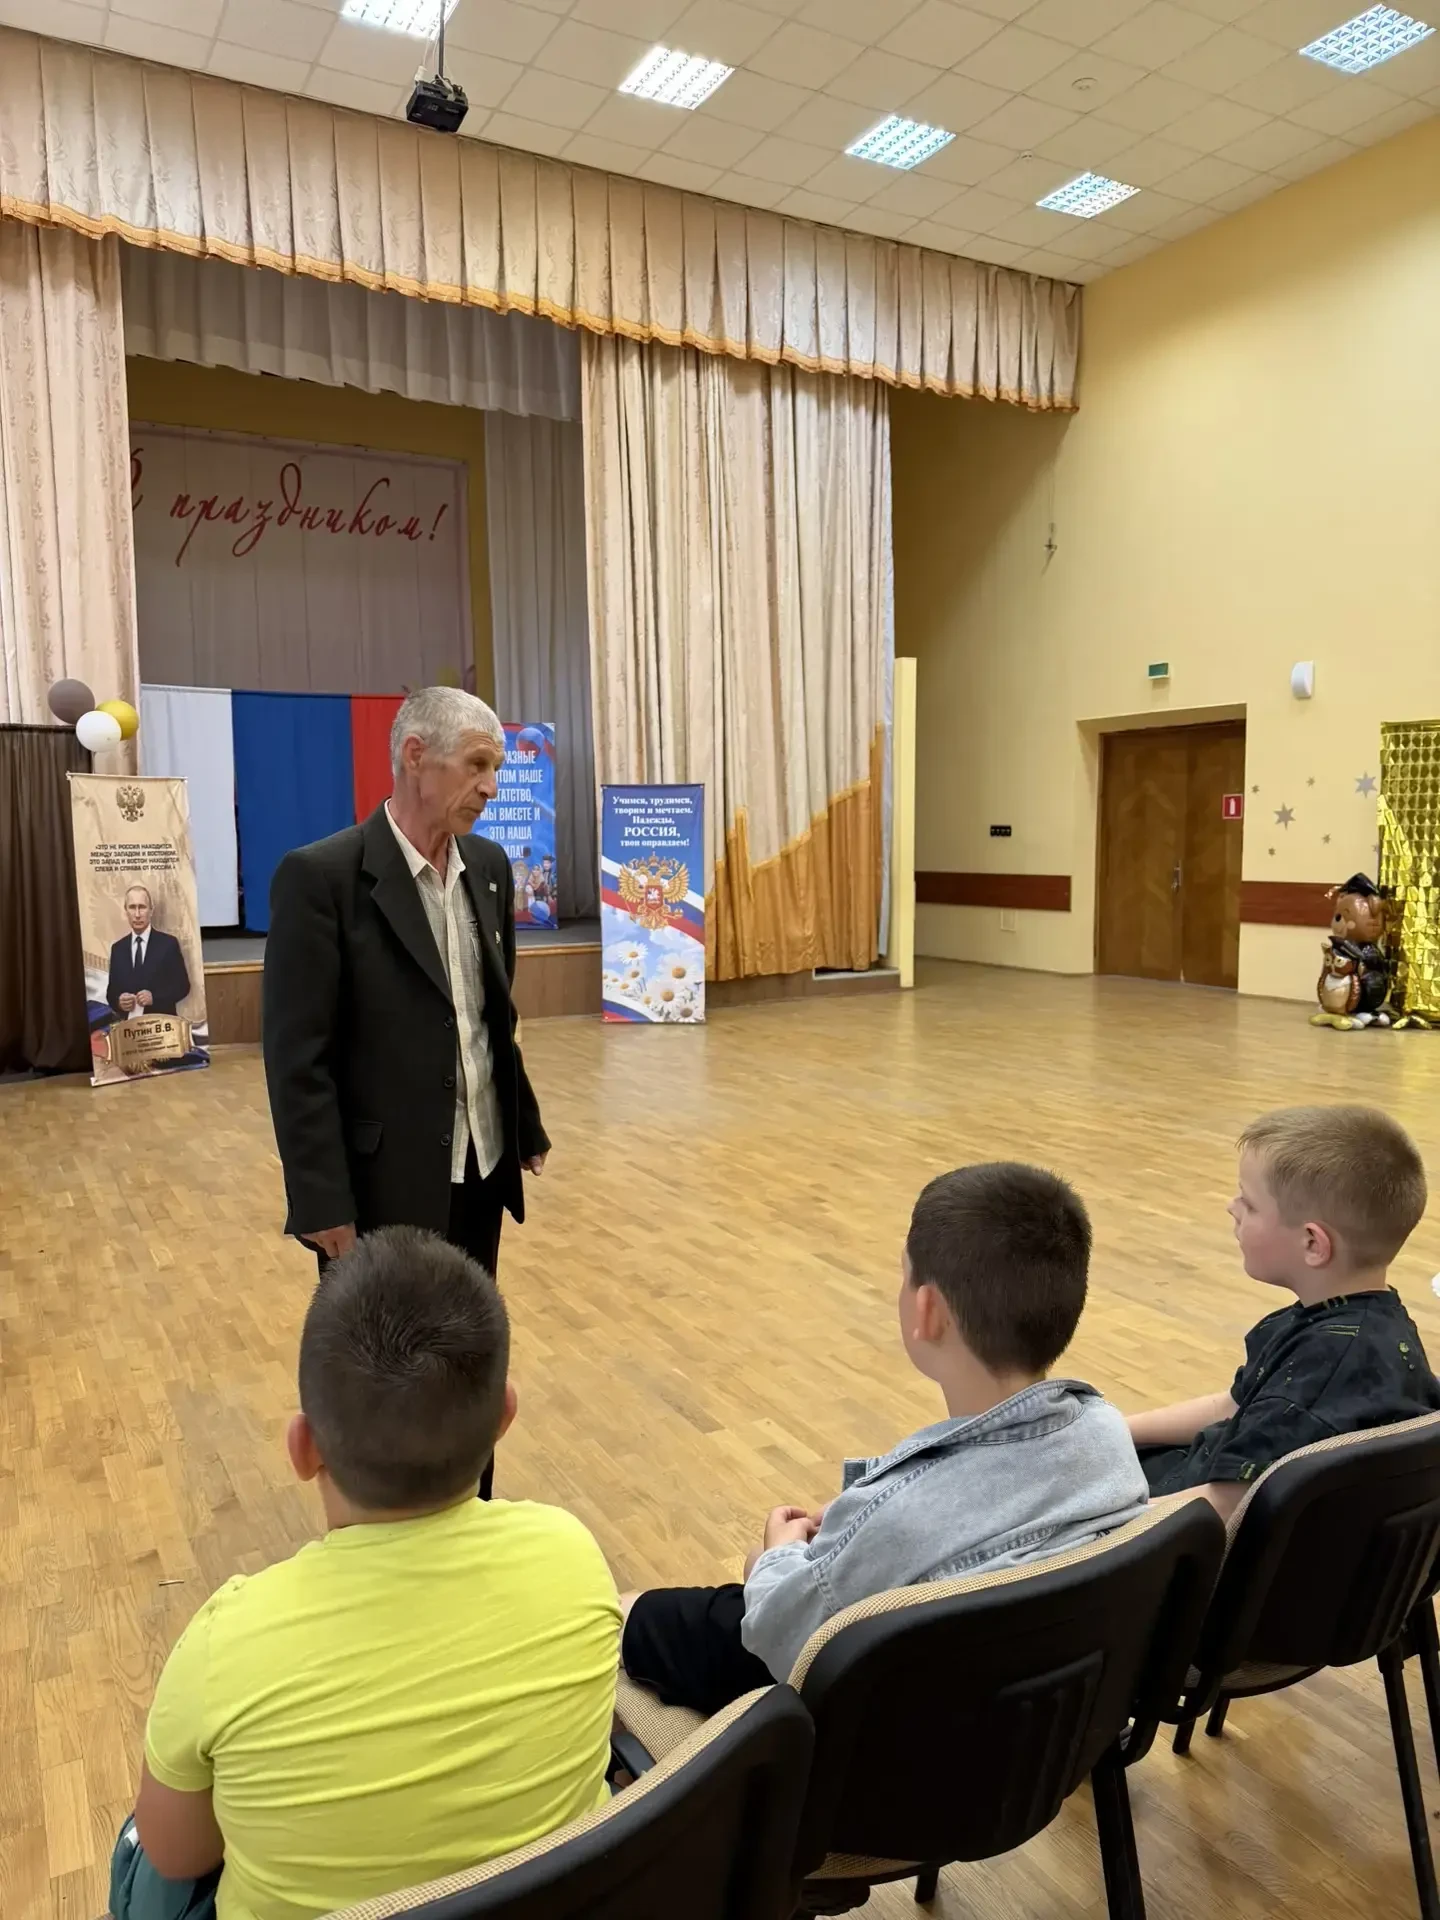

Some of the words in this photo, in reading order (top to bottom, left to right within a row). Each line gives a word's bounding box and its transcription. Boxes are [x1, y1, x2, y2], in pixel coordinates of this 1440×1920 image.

[170, 463, 448, 567] праздником!
[519, 769, 544, 784] НАШЕ
[487, 788, 535, 803] ГАТСТВО,
[612, 796, 649, 805] Учимся,
[650, 797, 693, 806] трудимся,
[480, 807, 497, 821] МЫ
[499, 807, 532, 821] ВМЕСТЕ
[534, 807, 541, 821] И
[614, 807, 646, 816] творим
[632, 816, 675, 825] Надежды,
[489, 826, 506, 840] ЭТО
[507, 826, 533, 840] НАША
[624, 826, 681, 838] РОССИЯ,
[620, 839, 640, 847] твои
[641, 838, 690, 848] оправдаем!
[123, 1027, 152, 1039] Путин
[155, 1022, 175, 1034] В.В.
